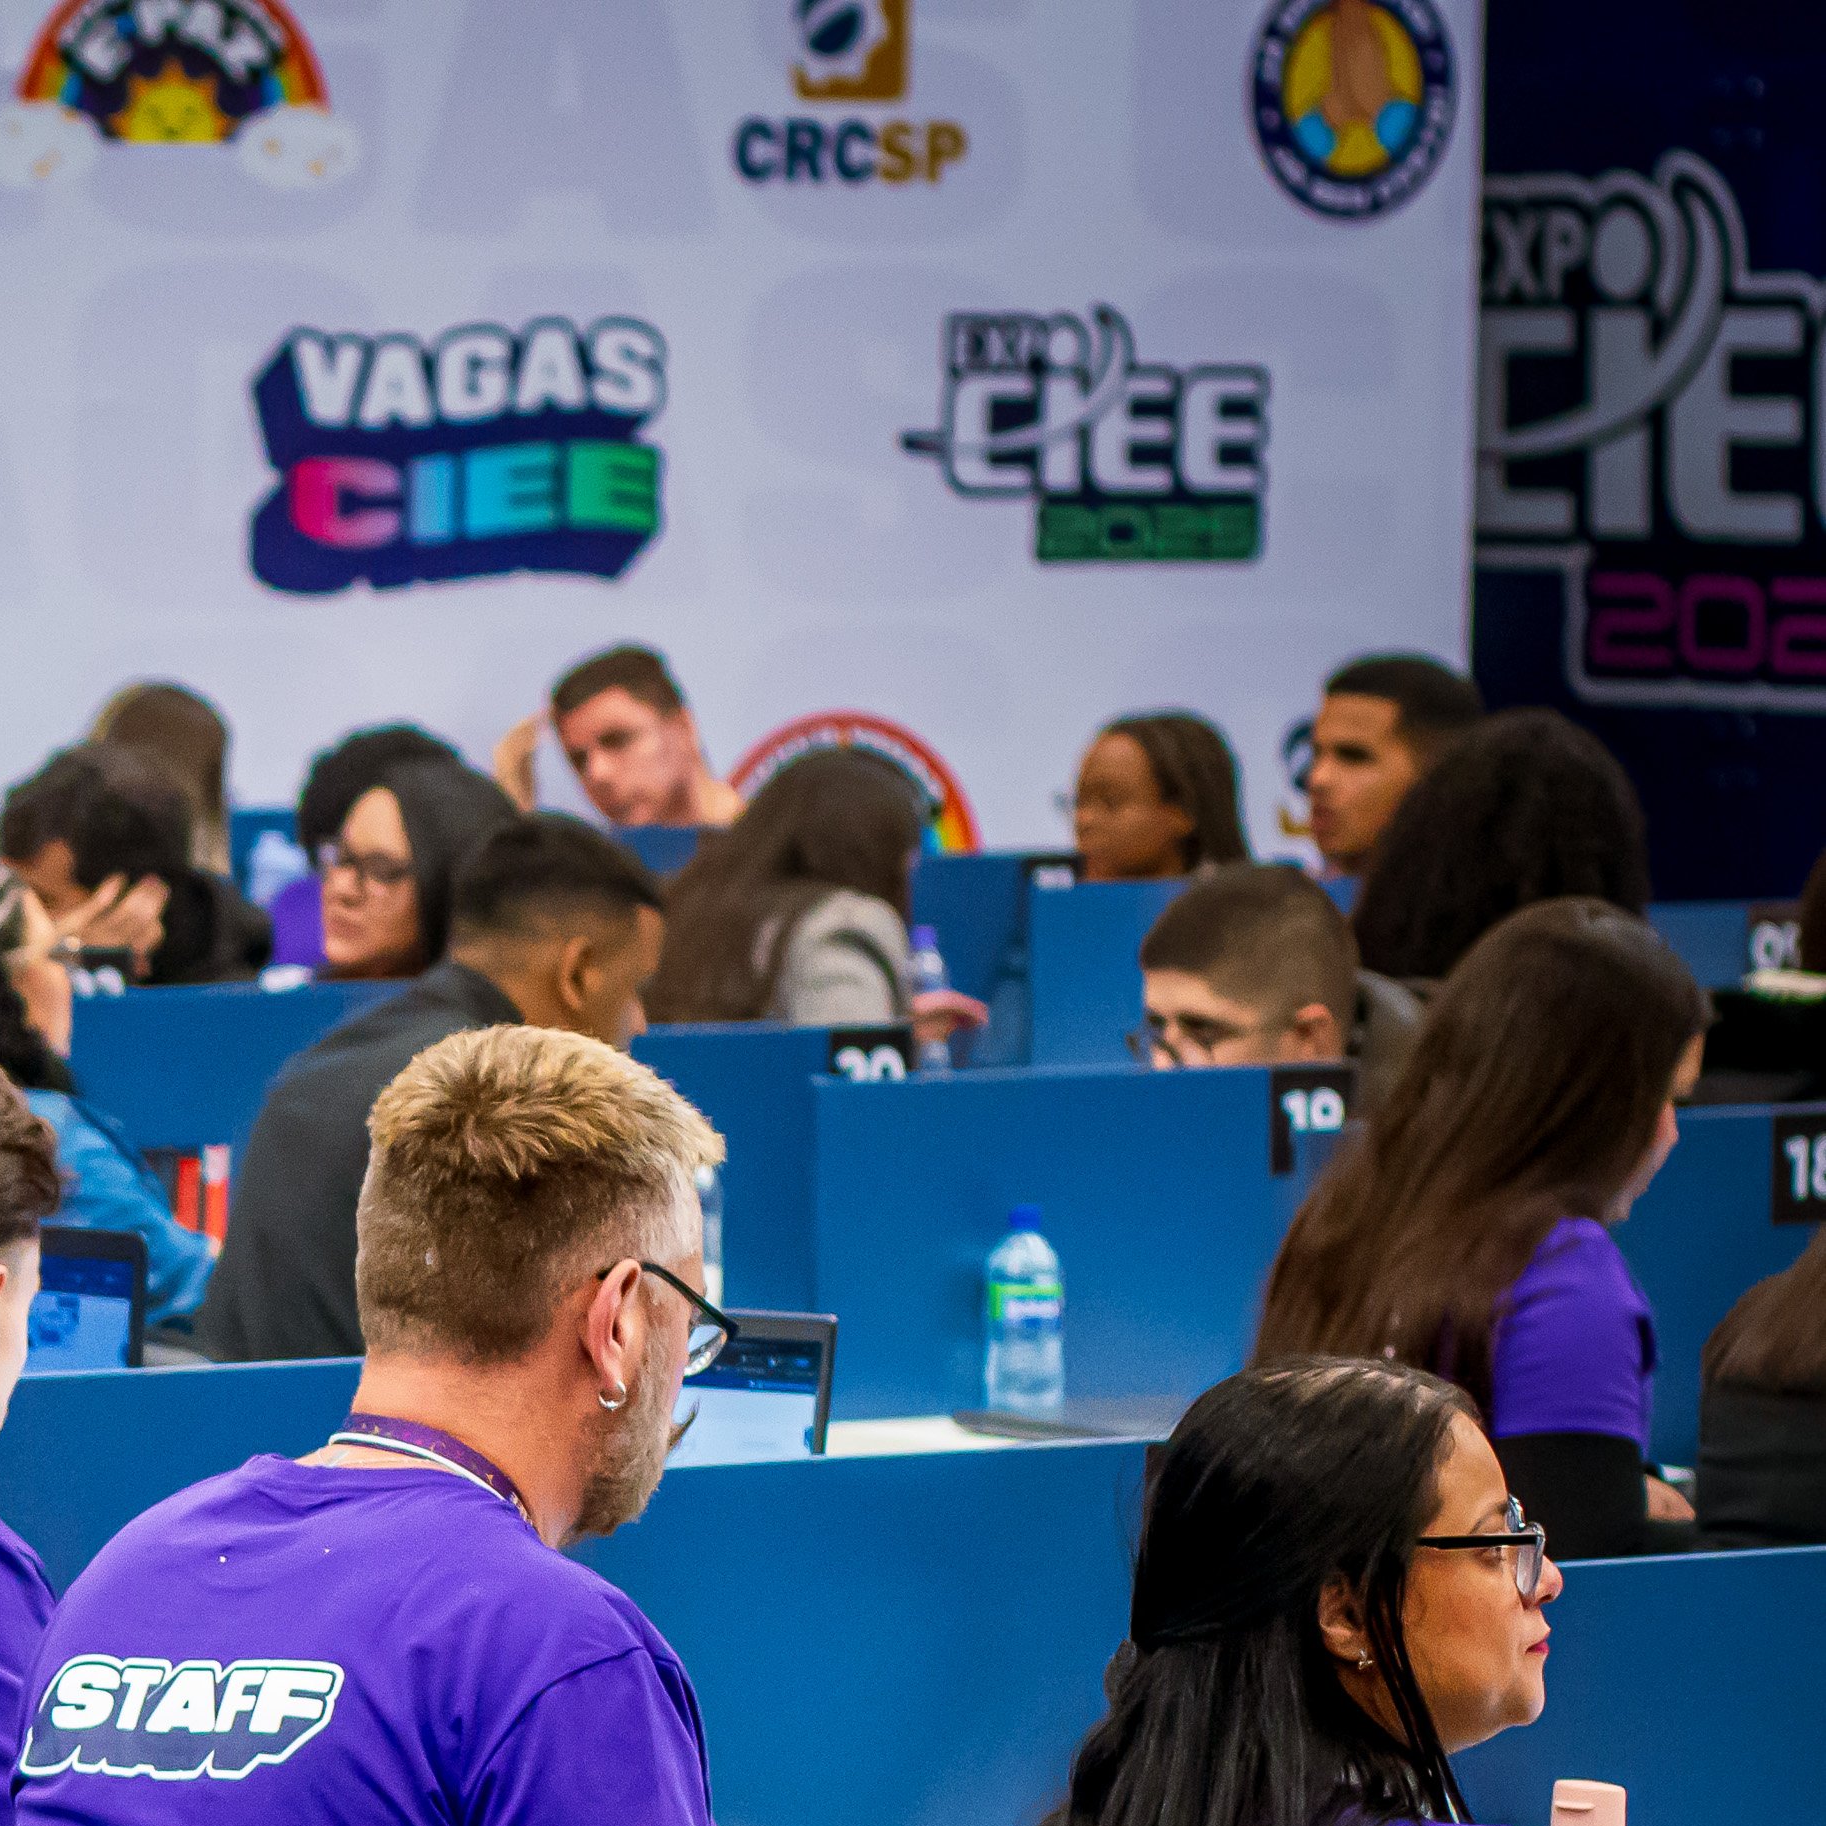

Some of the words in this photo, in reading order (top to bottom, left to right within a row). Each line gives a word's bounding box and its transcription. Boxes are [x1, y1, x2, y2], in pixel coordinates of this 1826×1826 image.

[732, 118, 968, 185] CRCSP
[293, 325, 659, 430] VAGAS
[1477, 307, 1826, 540] CIE
[951, 375, 1260, 493] CIEE
[289, 439, 659, 550] CIEE
[1589, 572, 1826, 675] 202
[50, 1662, 335, 1735] STAFF
